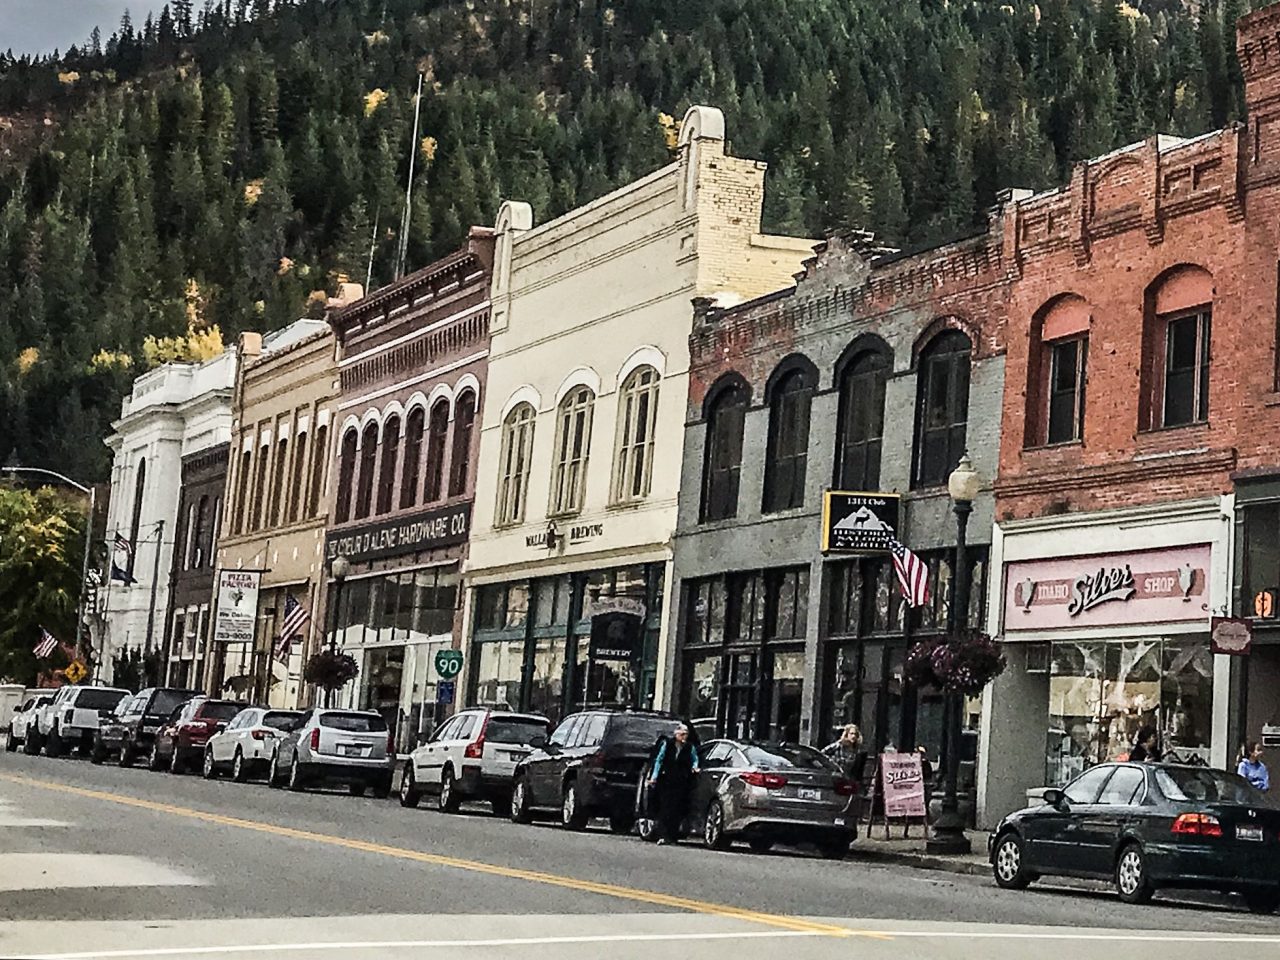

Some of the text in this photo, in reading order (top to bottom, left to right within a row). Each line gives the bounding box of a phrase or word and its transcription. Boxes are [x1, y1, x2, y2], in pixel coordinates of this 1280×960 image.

[398, 517, 448, 545] HARDWARE
[1038, 565, 1175, 616] IDAHO Silver SHOP
[440, 659, 459, 674] 90
